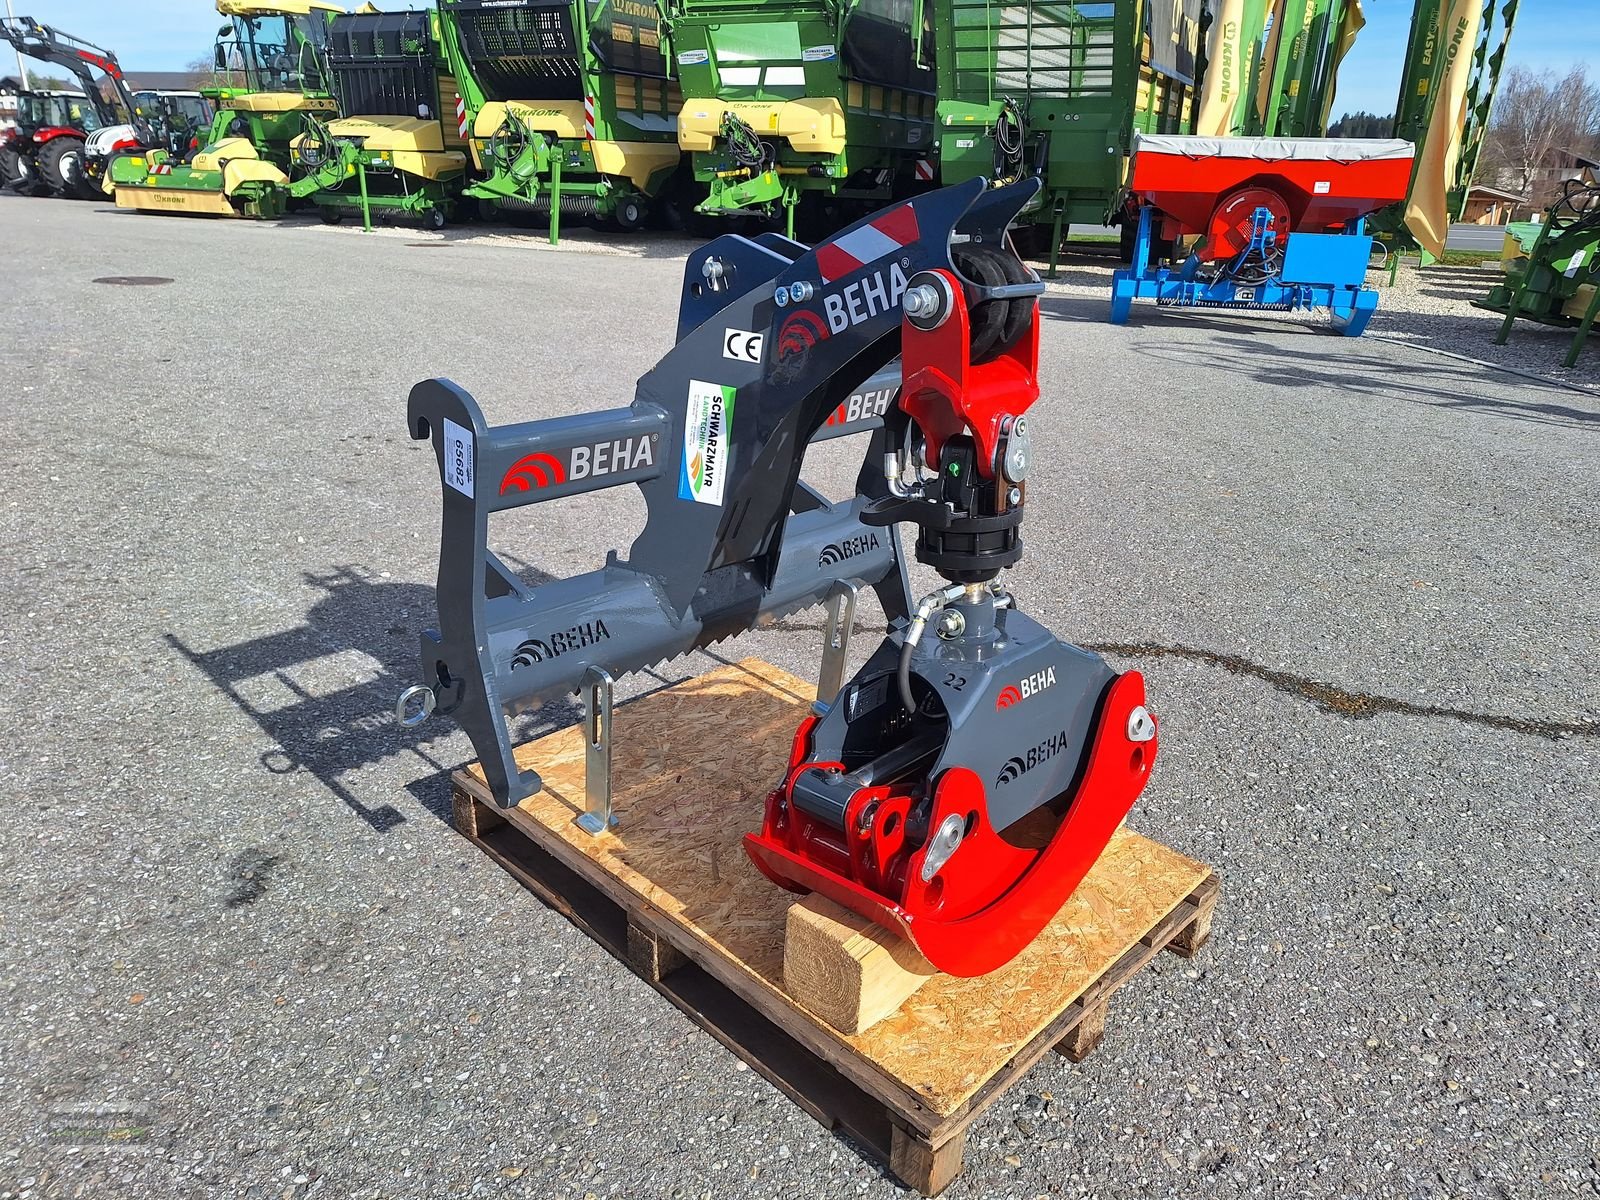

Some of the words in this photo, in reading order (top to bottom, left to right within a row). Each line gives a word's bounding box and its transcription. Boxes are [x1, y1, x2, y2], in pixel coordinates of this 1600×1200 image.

[1220, 41, 1235, 103] KRONE
[522, 109, 563, 117] KRONE
[162, 196, 186, 204] KRONE
[726, 332, 761, 362] CE
[698, 396, 710, 450] LANDTECHNIK
[845, 387, 899, 423] BEH
[703, 395, 723, 487] SCHWARZMAYR
[455, 439, 464, 487] 65682
[842, 532, 880, 560] BEHA
[550, 618, 611, 657] BEHA
[942, 672, 967, 692] 22
[1026, 730, 1068, 773] BEHA
